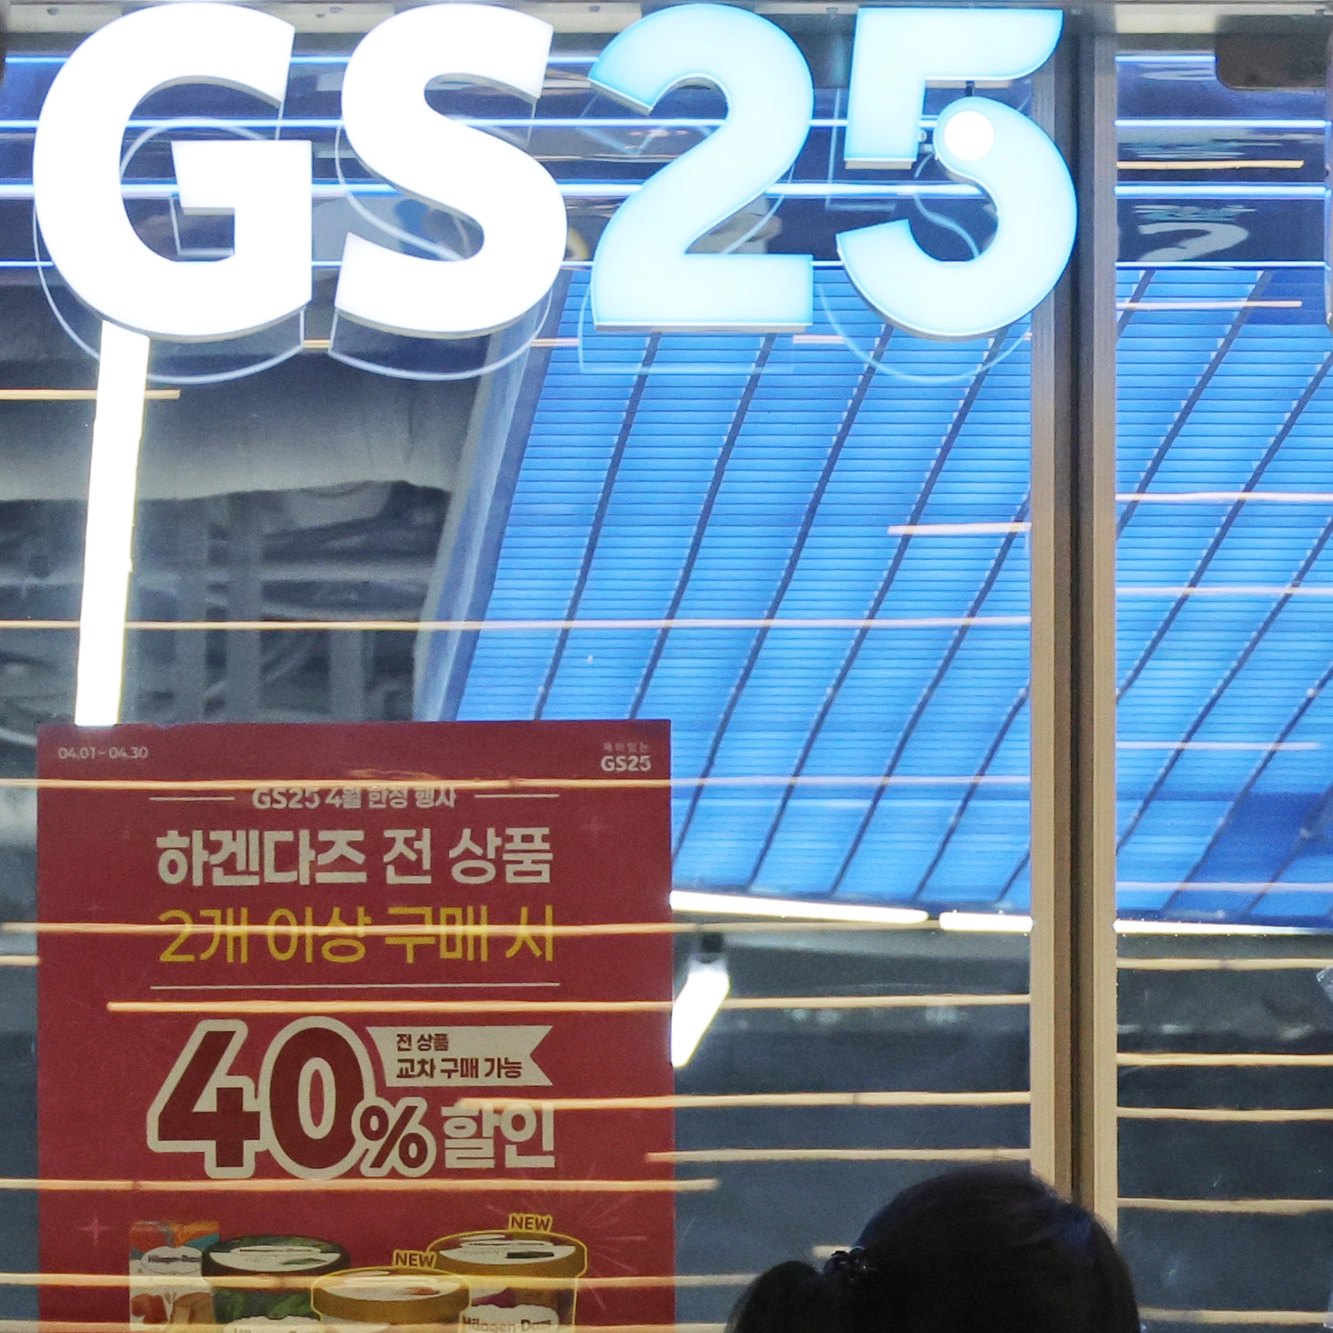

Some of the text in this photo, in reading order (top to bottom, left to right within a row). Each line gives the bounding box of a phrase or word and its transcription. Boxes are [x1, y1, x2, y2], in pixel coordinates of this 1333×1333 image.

[33, 3, 1077, 341] GS25
[108, 746, 148, 760] 04.30
[601, 755, 652, 772] GS25
[252, 787, 321, 809] GS25
[156, 826, 554, 887] 하겐다즈 전 상품
[158, 904, 554, 963] 2개 이상 구매 시
[396, 1033, 449, 1052] 전 상품
[396, 1056, 522, 1079] 교차 구매 가능
[150, 1018, 434, 1176] 40%
[441, 1103, 555, 1169] 할인
[511, 1215, 551, 1231] NEW
[395, 1251, 436, 1267] NEW
